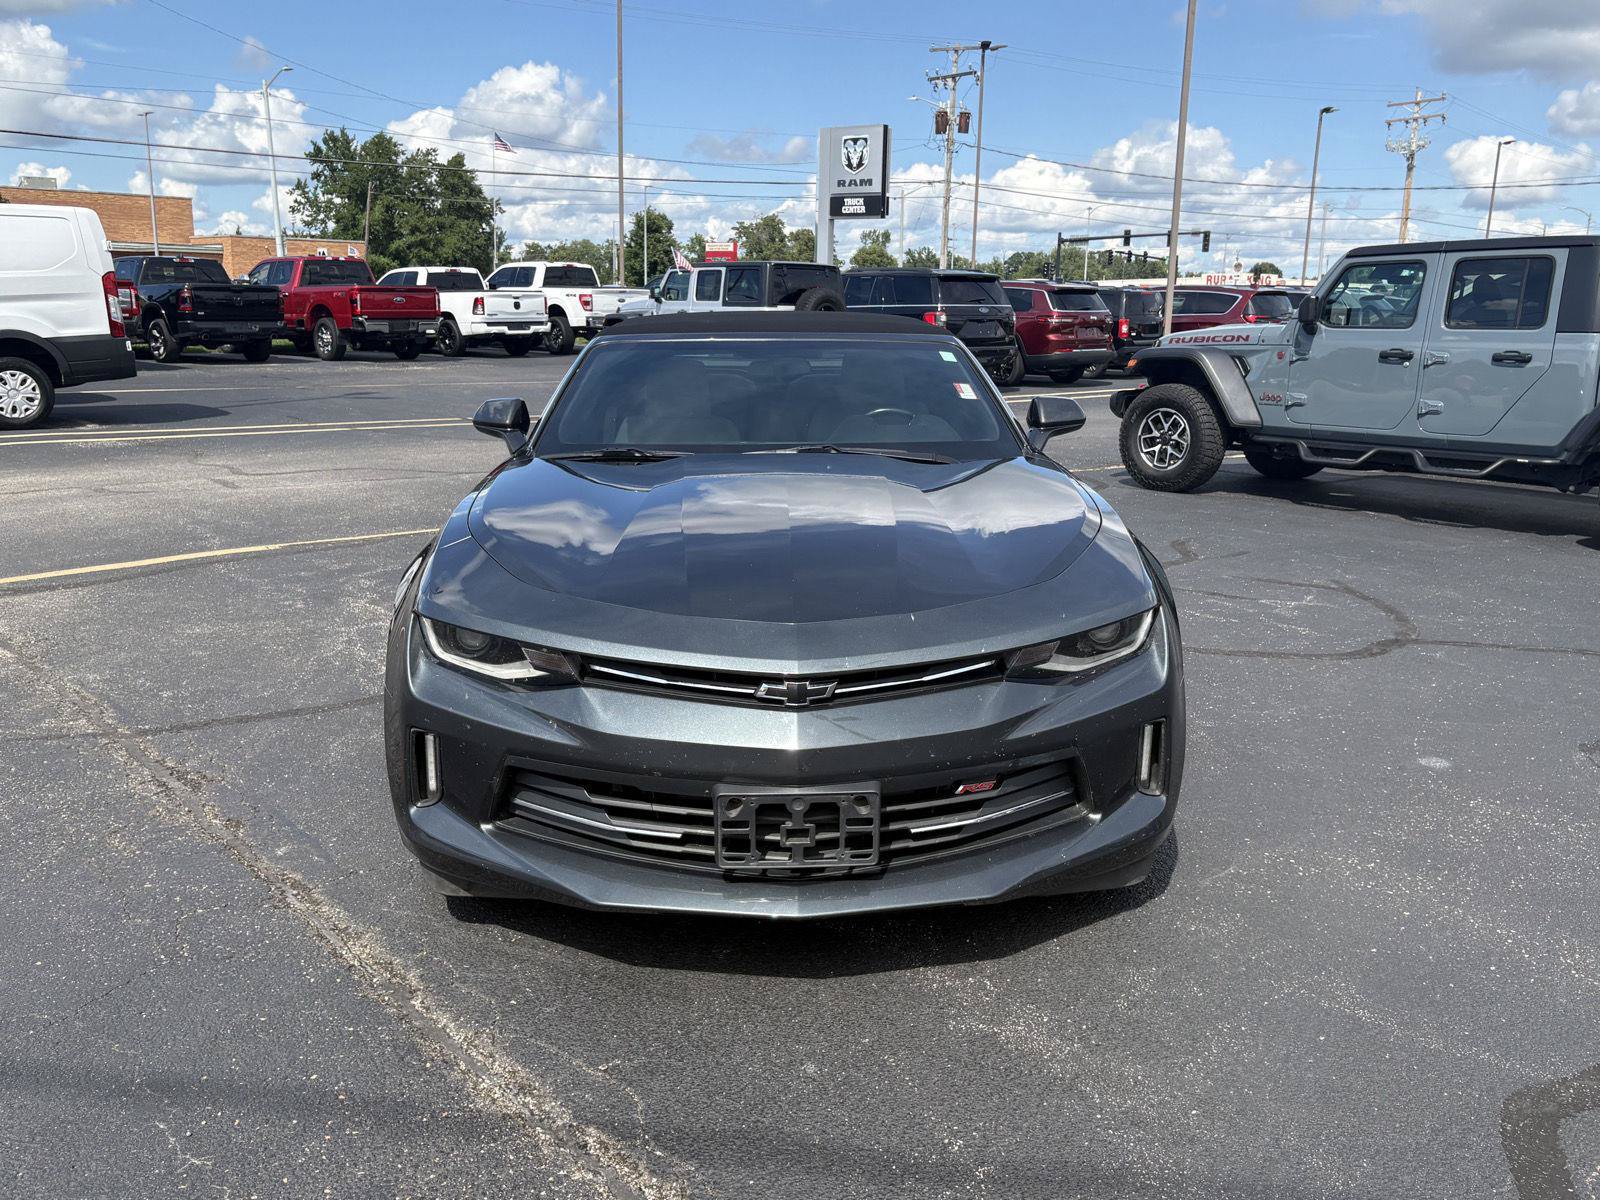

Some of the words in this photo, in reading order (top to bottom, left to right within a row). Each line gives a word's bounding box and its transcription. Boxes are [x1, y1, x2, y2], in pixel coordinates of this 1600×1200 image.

[837, 178, 873, 188] RAM
[843, 197, 865, 206] TRUCK
[841, 205, 866, 214] CENTER
[1247, 275, 1272, 286] KNG
[1168, 335, 1250, 345] RUBICON
[1259, 392, 1283, 404] Jeep
[957, 780, 996, 795] RS
